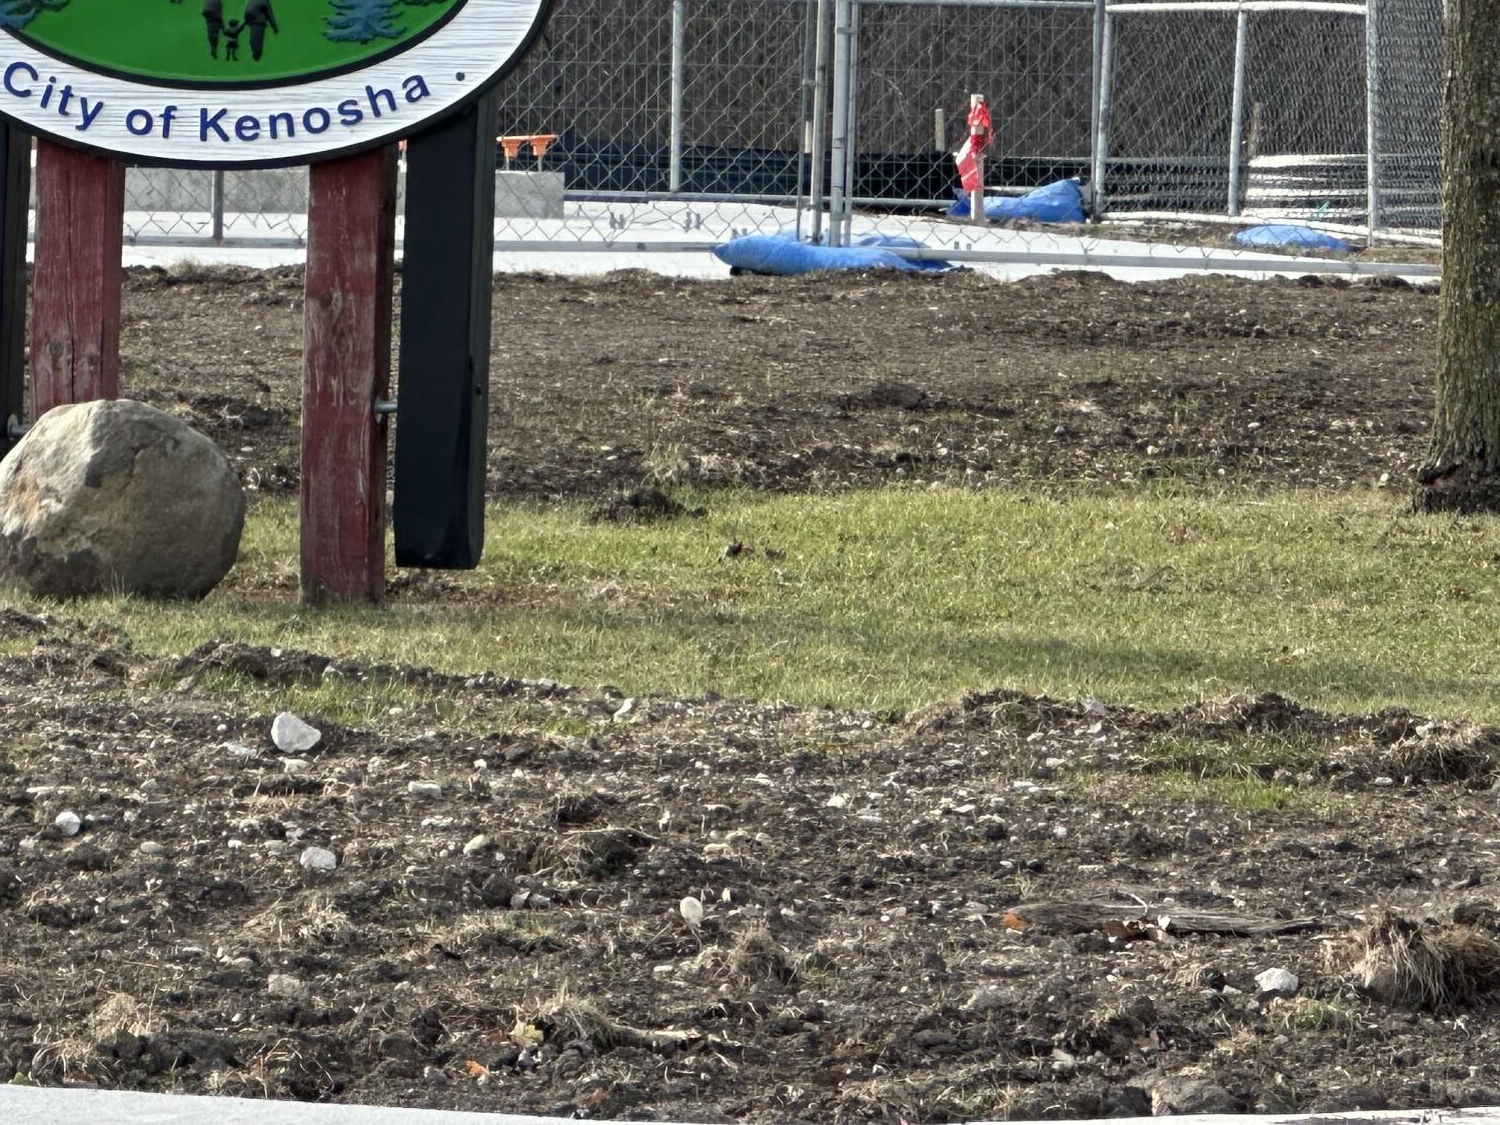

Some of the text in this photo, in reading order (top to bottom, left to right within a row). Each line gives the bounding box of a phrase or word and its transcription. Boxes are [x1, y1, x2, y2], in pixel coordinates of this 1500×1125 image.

[3, 62, 430, 141] City of Kenosha
